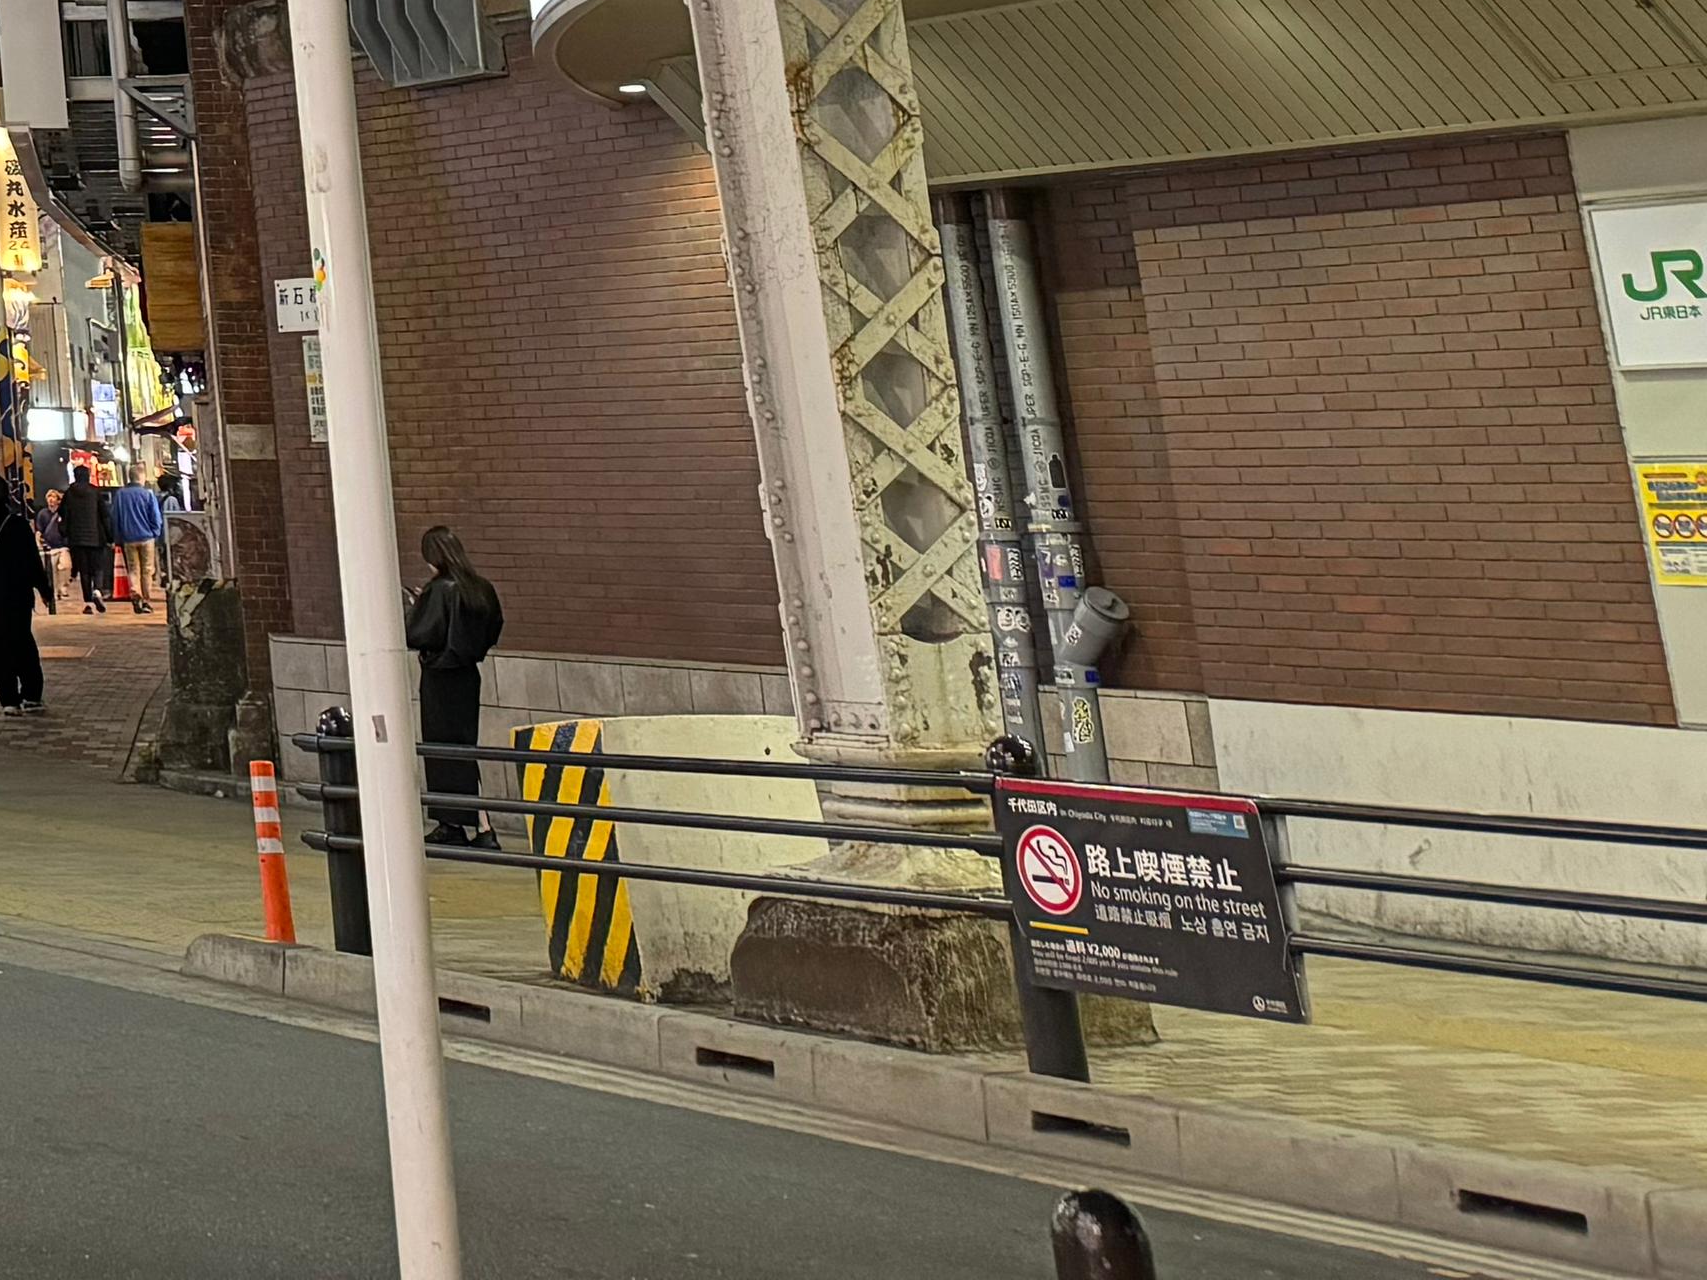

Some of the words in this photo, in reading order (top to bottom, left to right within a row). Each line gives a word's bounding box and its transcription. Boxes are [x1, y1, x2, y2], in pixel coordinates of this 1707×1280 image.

[1622, 249, 1704, 303] JR
[1640, 305, 1703, 320] JR東日本
[1008, 797, 1058, 817] 千代田区内
[1085, 843, 1243, 893] 路上喫煙禁止
[1091, 880, 1111, 900] No
[1113, 884, 1173, 912] smoking
[1175, 895, 1193, 911] on
[1195, 893, 1220, 914] the
[1222, 898, 1268, 920] street
[1181, 915, 1207, 935] 노상
[1241, 921, 1271, 944] 금지
